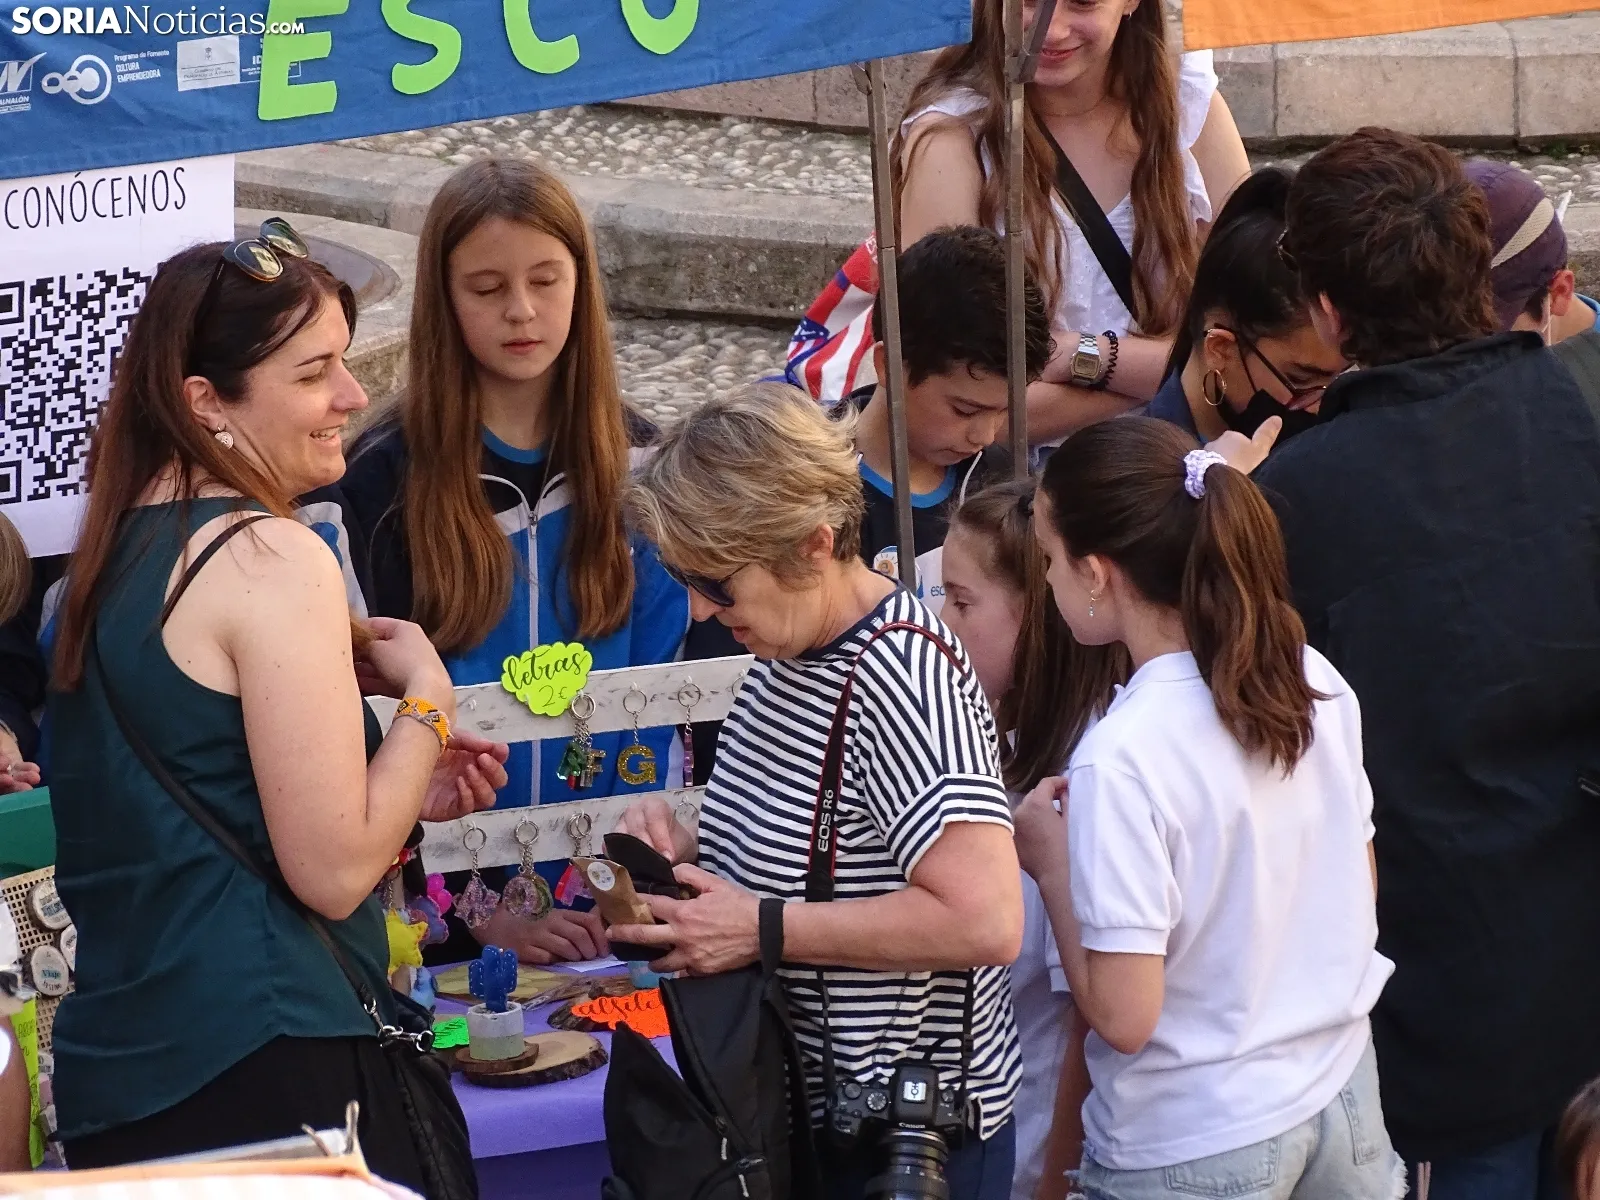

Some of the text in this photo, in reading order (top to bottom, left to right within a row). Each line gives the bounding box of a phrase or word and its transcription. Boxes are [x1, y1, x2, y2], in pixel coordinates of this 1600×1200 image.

[115, 62, 140, 73] CULTURA
[117, 69, 161, 83] EMPRENDEDORA
[4, 166, 187, 230] CONÓCENOS
[507, 649, 588, 690] letras
[617, 745, 656, 785] G
[817, 789, 834, 853] EOS R6
[578, 992, 662, 1020] alfile
